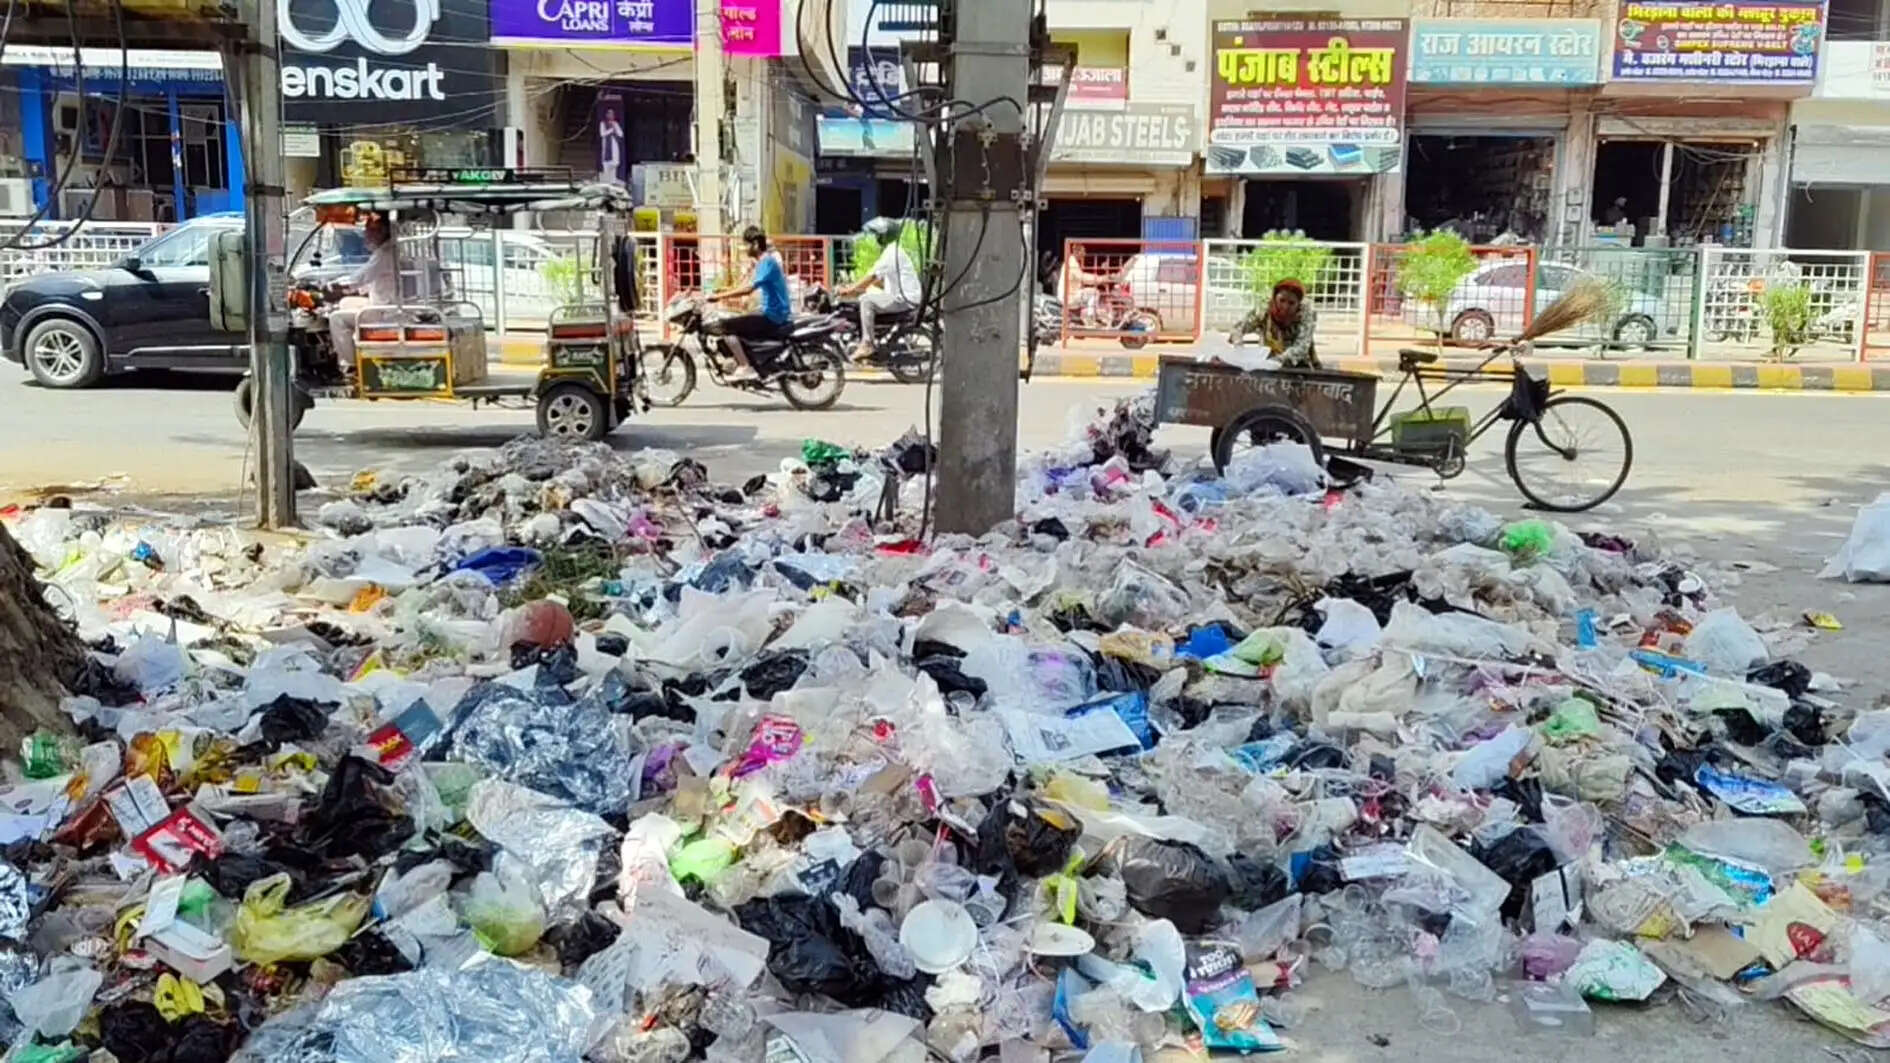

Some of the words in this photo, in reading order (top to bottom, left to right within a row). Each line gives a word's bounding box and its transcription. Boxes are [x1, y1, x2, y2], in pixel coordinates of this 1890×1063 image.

[537, 0, 609, 21] CAPRI
[562, 19, 609, 31] LOANS
[1421, 33, 1462, 55] राज
[1467, 33, 1545, 55] आयरन
[1549, 28, 1593, 55] स्टोर
[1217, 36, 1301, 84] पंजाब
[1307, 37, 1395, 83] स्टील्स
[282, 57, 445, 99] enskart
[1110, 115, 1190, 149] STEELS
